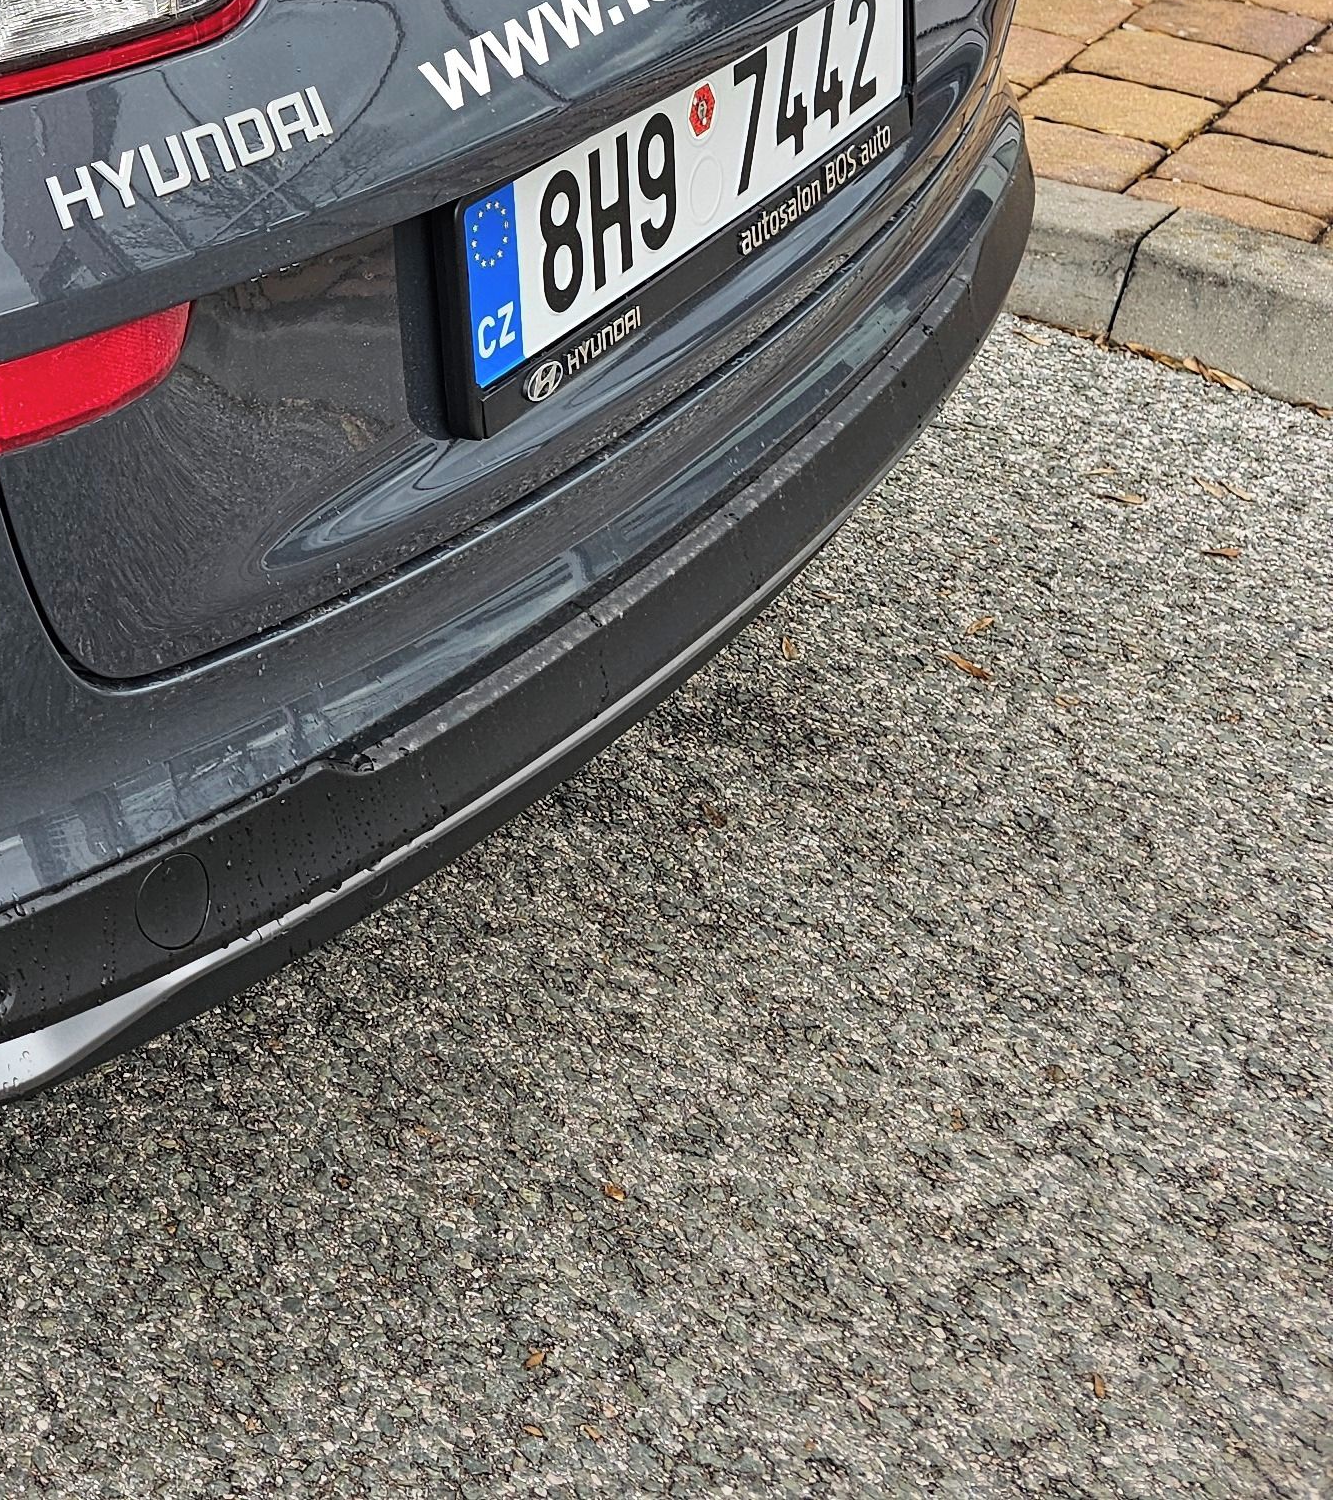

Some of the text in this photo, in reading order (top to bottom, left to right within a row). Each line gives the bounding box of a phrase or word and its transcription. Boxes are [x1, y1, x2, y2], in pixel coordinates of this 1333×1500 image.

[45, 86, 333, 230] HYUNDAI
[539, 111, 677, 314] 8H9
[740, 125, 891, 256] autosalon BOS auto
[477, 301, 516, 359] CZ
[567, 306, 642, 375] HYUNDAI
